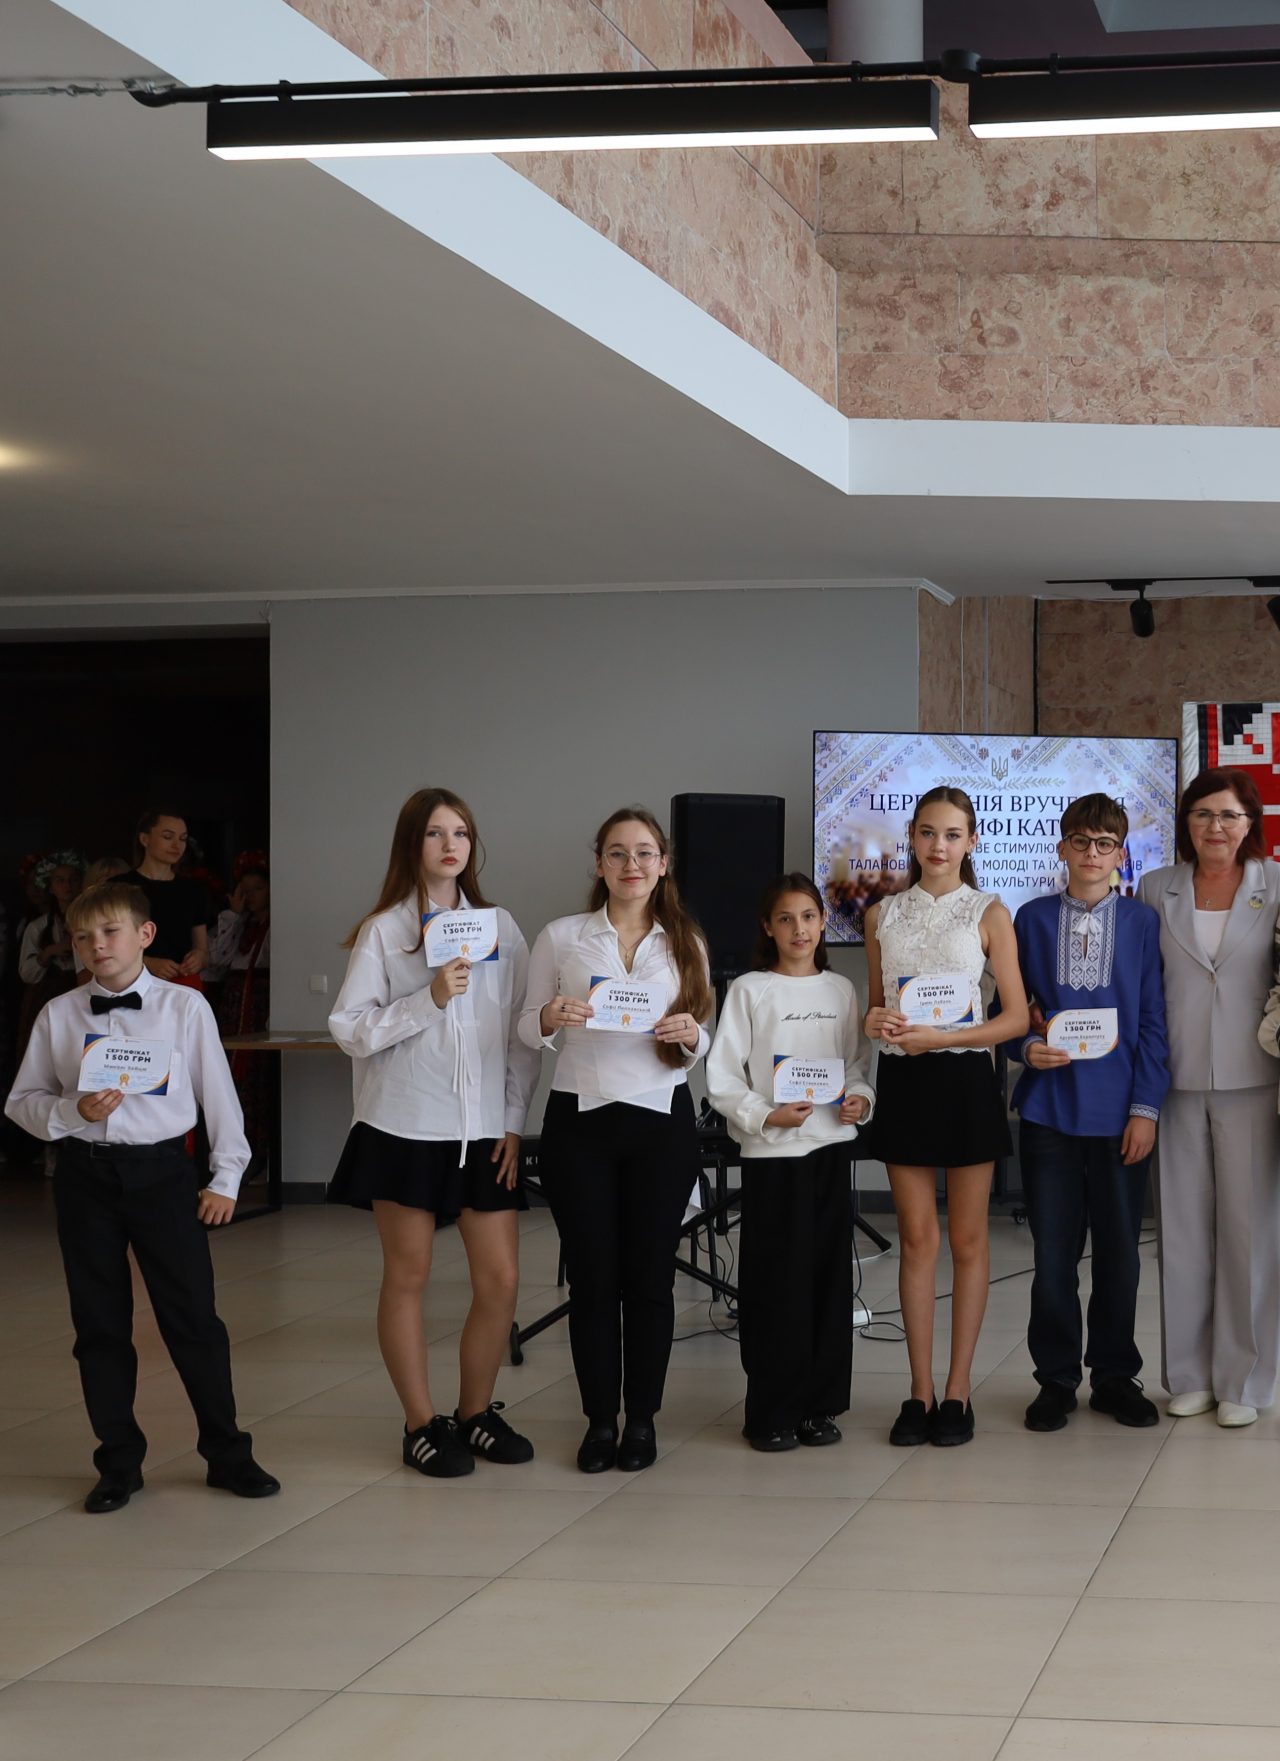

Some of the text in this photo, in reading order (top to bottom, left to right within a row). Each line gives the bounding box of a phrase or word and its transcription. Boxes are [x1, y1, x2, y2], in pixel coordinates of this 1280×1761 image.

[869, 793, 1128, 815] ЦЕРНІЯ ВРУЧЯ
[993, 842, 1059, 854] СТИМУЛЮ
[849, 858, 910, 871] ТАЛАНОВ
[982, 859, 1029, 873] МОЛОДІ
[1032, 859, 1046, 871] ТА
[1048, 856, 1060, 871] ЇХ
[993, 876, 1055, 888] КУЛЬТУРИ
[609, 989, 649, 997] СЕРТИФІКАТ
[632, 996, 649, 1004] ГРН
[106, 1047, 151, 1056] СЕРТИФІКАТ
[112, 1054, 129, 1062] 500
[132, 1055, 151, 1063] ГРН
